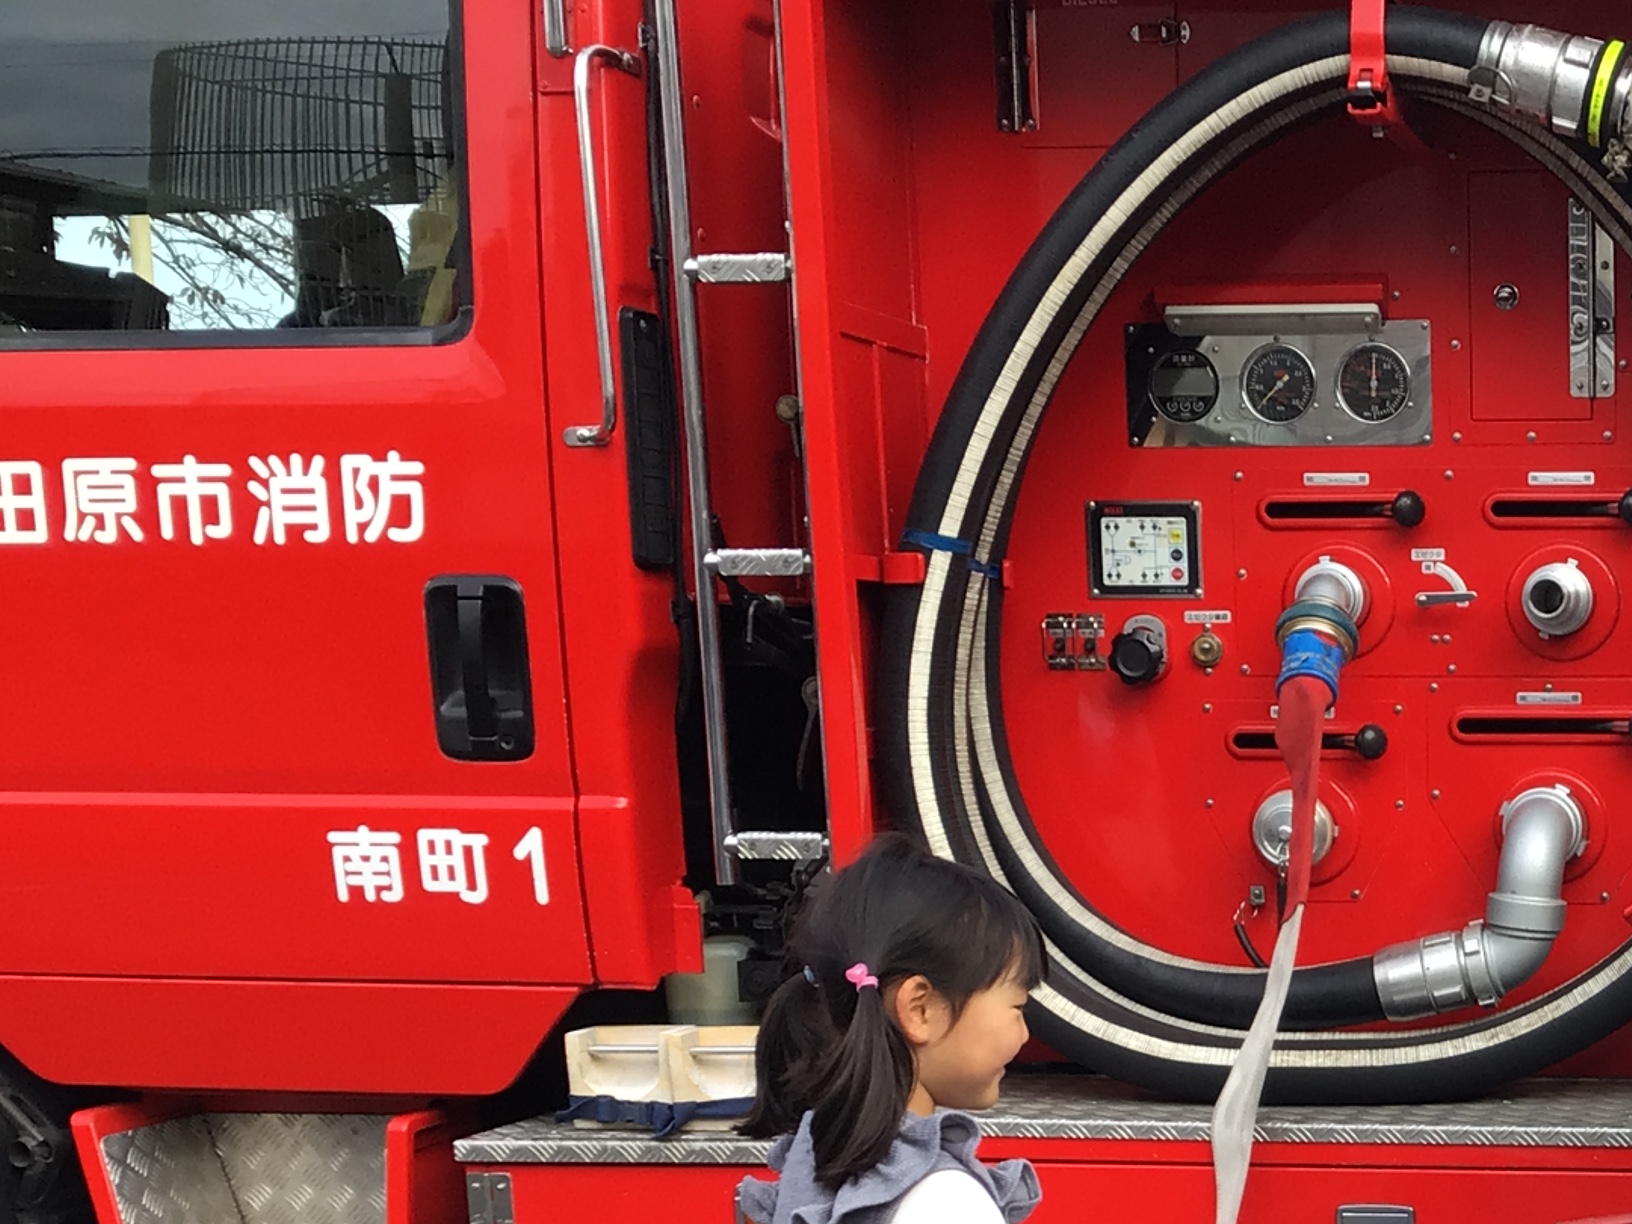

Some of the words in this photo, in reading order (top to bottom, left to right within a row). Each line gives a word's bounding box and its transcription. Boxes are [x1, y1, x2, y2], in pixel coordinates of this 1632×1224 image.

[0, 450, 425, 546] 田原市消防
[326, 824, 549, 905] 南町1
